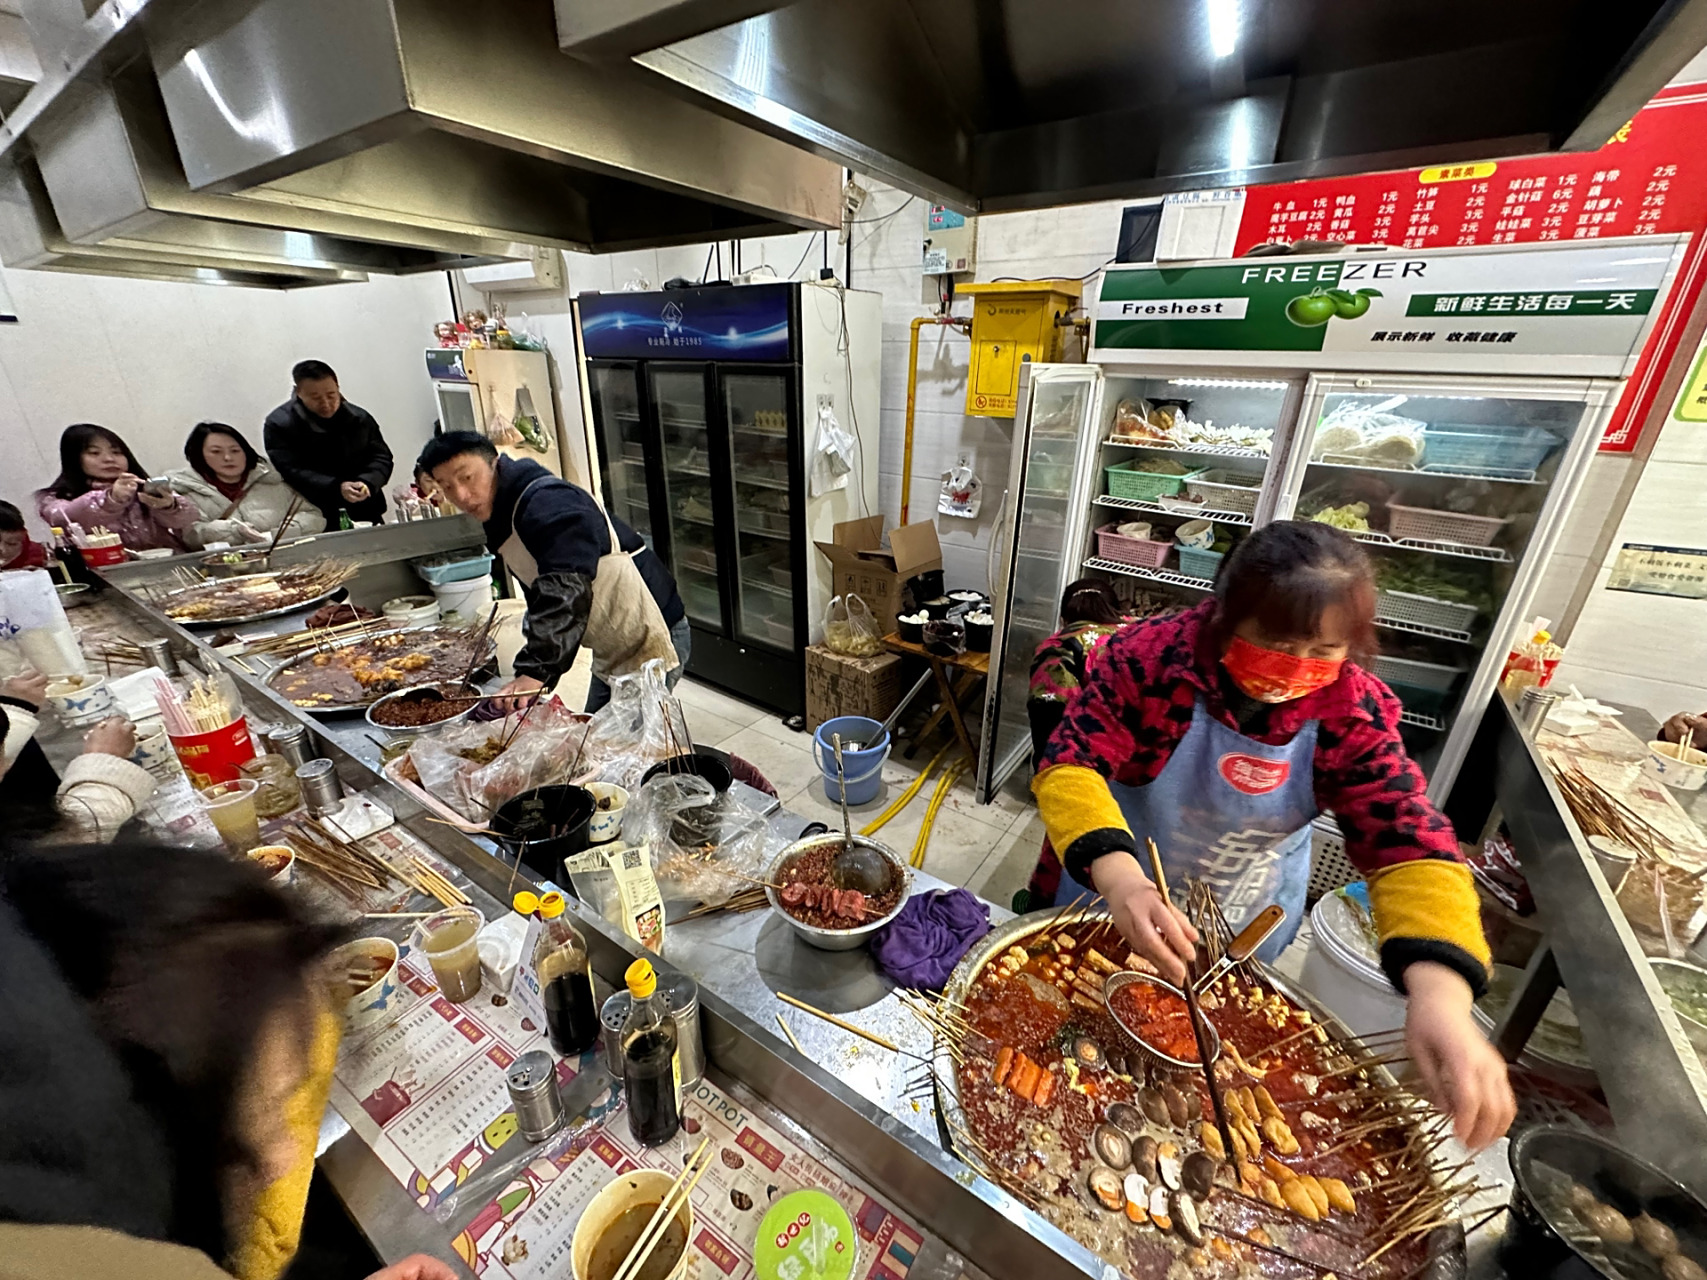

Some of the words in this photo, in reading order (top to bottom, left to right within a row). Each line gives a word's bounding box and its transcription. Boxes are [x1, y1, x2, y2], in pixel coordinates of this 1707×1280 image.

[1313, 197, 1328, 208] 1元
[1335, 194, 1356, 206] 鸭血
[1382, 190, 1398, 202] 1元
[1471, 182, 1489, 194] 1元
[1508, 176, 1548, 190] 球白菜
[1558, 173, 1578, 186] 1元
[1592, 169, 1621, 183] 海带
[1653, 164, 1677, 177] 2元
[1270, 210, 1308, 223] 魔芋豆腐
[1309, 209, 1326, 220] 2元
[1333, 207, 1353, 218] 黄瓜
[1378, 203, 1396, 215] 2元
[1412, 200, 1436, 212] 土豆
[1465, 195, 1486, 208] 2元
[1505, 190, 1544, 204] 金针菇
[1552, 187, 1574, 200] 6元
[1646, 179, 1670, 192] 2元
[1268, 224, 1287, 235] 木耳
[1306, 221, 1322, 232] 2元
[1330, 219, 1351, 230] 香菇
[1374, 216, 1392, 227] 3元
[1409, 212, 1431, 225] 芋头
[1464, 208, 1484, 220] 3元
[1500, 205, 1526, 218] 平菇
[1547, 201, 1570, 214] 2元
[1583, 197, 1623, 211] 胡萝卜
[1642, 194, 1666, 207] 2元
[1326, 230, 1357, 242] 空心菜
[1371, 228, 1389, 239] 3元
[1460, 221, 1479, 233] 3元
[1494, 217, 1533, 231] 娃娃菜
[1541, 215, 1562, 227] 3元
[1576, 211, 1618, 225] 豆芽菜
[1638, 208, 1662, 220] 2元
[1402, 238, 1425, 249] 花菜
[1456, 234, 1476, 245] 2元
[1491, 231, 1517, 244] 生菜
[1539, 229, 1560, 240] 3元
[1633, 223, 1656, 235] 3元
[1241, 262, 1428, 284] FREEZER
[1122, 301, 1224, 315] Freshest
[1434, 293, 1638, 312] 新鲜生活每一天
[1370, 331, 1436, 342] 展示新鲜
[1445, 331, 1518, 343] 收藏健康
